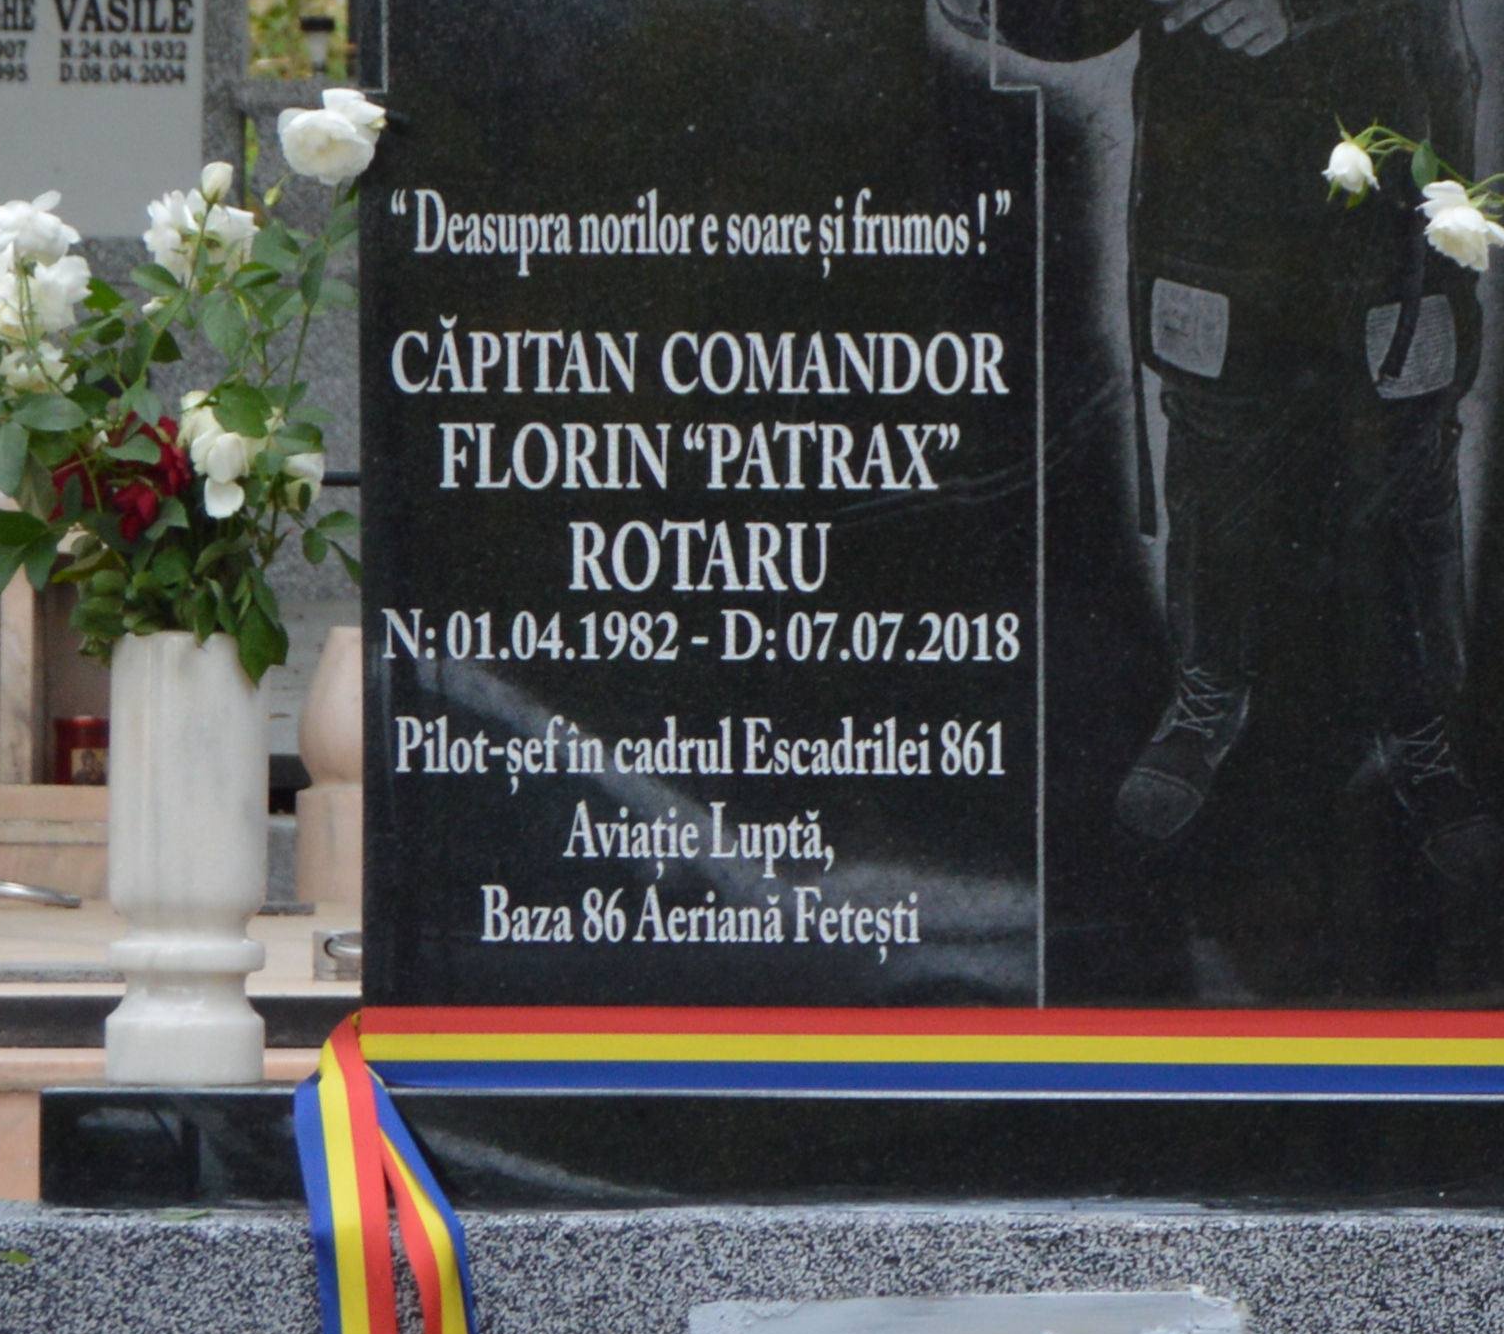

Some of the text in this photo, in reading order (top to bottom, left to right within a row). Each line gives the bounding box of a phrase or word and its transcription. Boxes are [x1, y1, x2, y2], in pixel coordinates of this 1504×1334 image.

[579, 189, 695, 255] norilor
[701, 213, 719, 255] e
[726, 213, 810, 255] soare
[820, 192, 846, 278] și
[390, 314, 1010, 396] CĂPITAN COMANDOR
[438, 422, 671, 490] FLORIN
[568, 519, 831, 593] ROTARU
[382, 608, 437, 661] N:
[445, 609, 680, 662] 01.04.1982
[720, 609, 779, 661] D:
[786, 610, 1022, 663] 07.07.2018
[613, 715, 733, 776] cadrul
[742, 715, 931, 776] Escadrilei
[939, 719, 1006, 776] 861
[563, 801, 700, 880] Aviație
[480, 885, 922, 964] Baza 86 Aeriană Fetești
